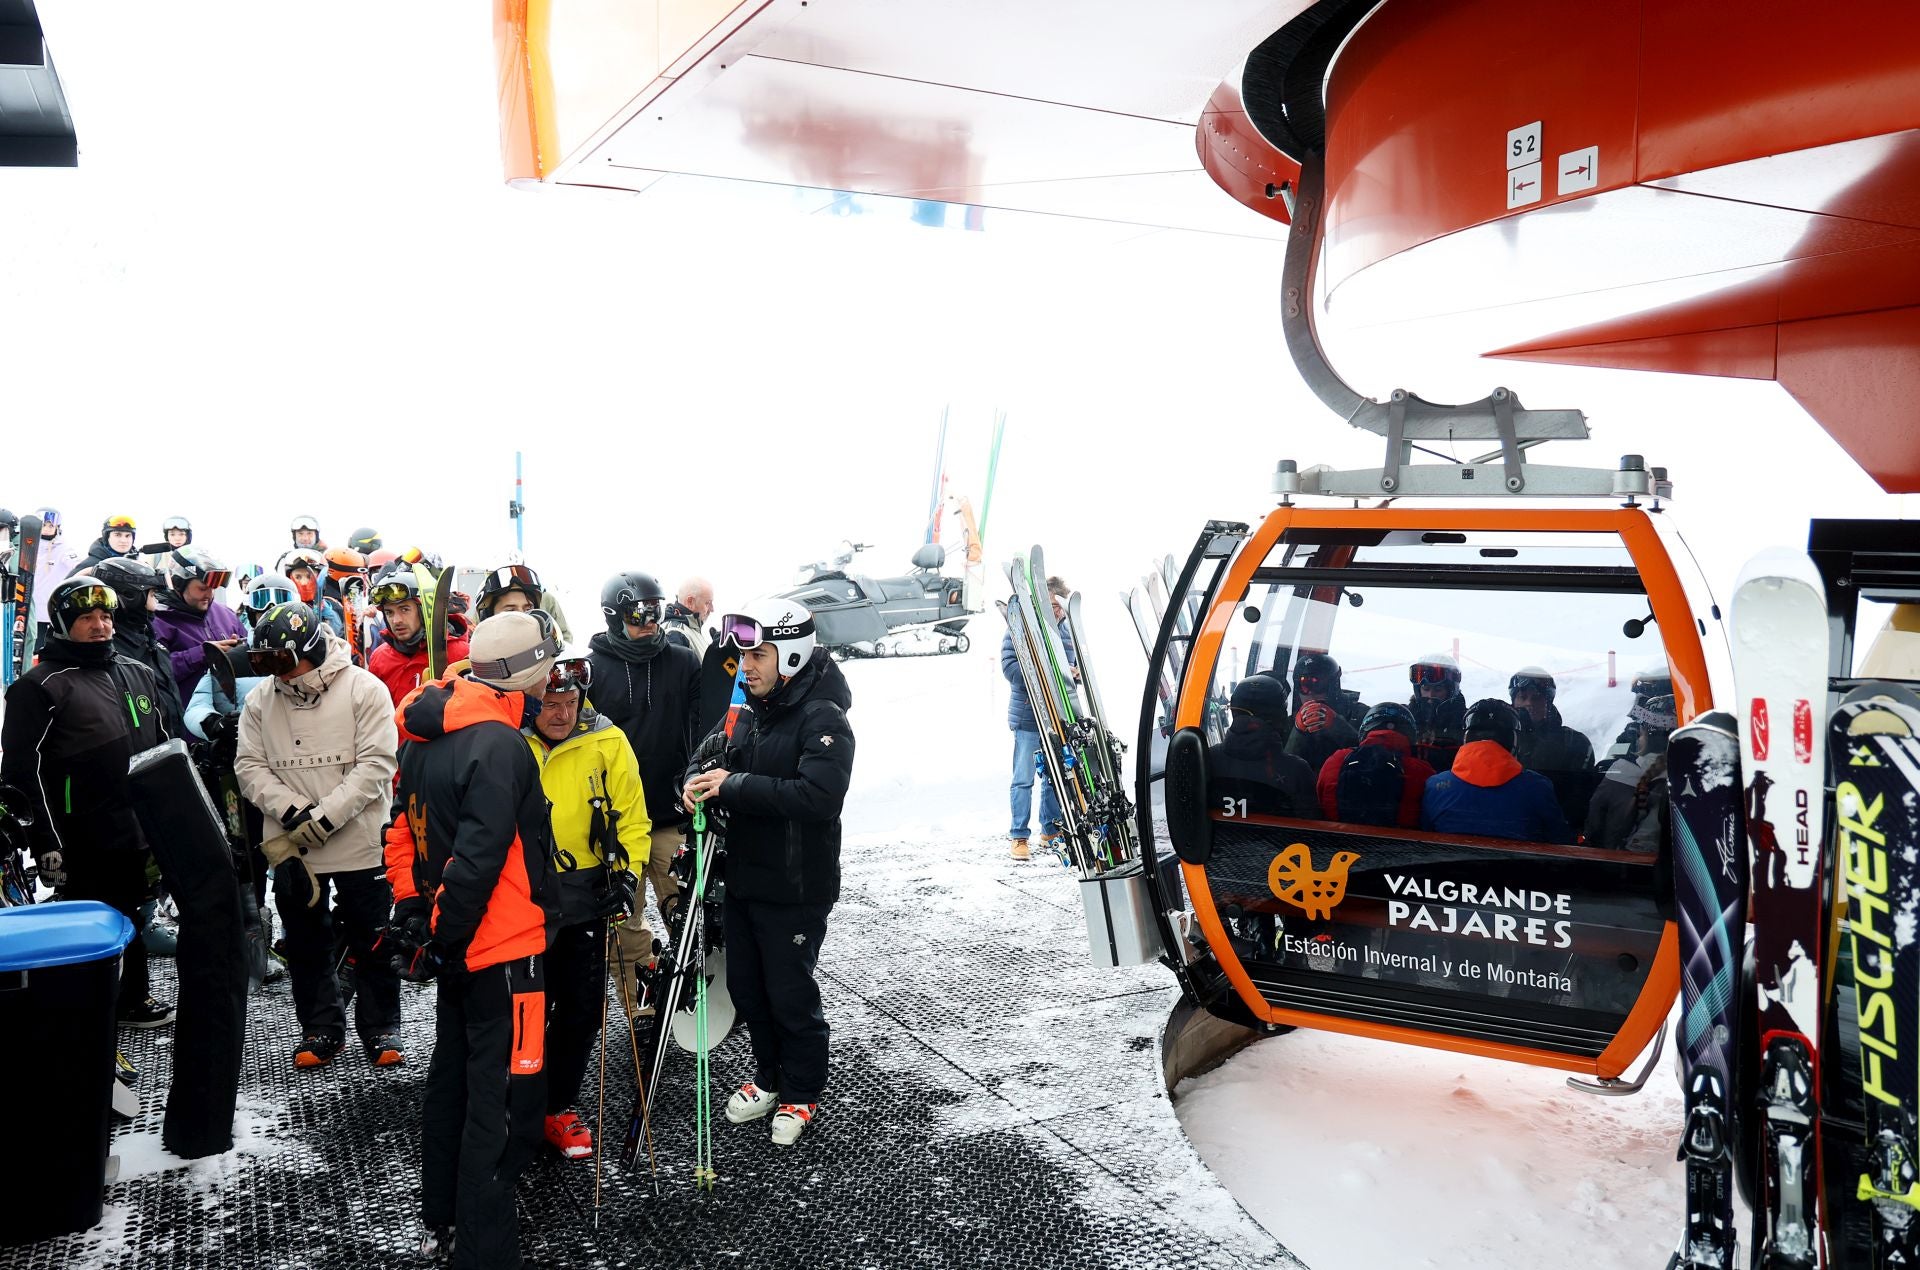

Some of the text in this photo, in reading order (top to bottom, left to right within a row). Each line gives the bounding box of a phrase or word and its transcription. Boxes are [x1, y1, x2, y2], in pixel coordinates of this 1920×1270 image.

[772, 626, 800, 637] POC
[309, 754, 341, 765] SNOW
[1222, 796, 1247, 819] 31
[1796, 788, 1810, 866] HEAD
[1383, 873, 1572, 916] VALGRANDE
[1387, 900, 1573, 950] PAJARES
[1835, 780, 1901, 1107] FISCHER
[1284, 933, 1572, 993] Estación Invernal y de Montaña
